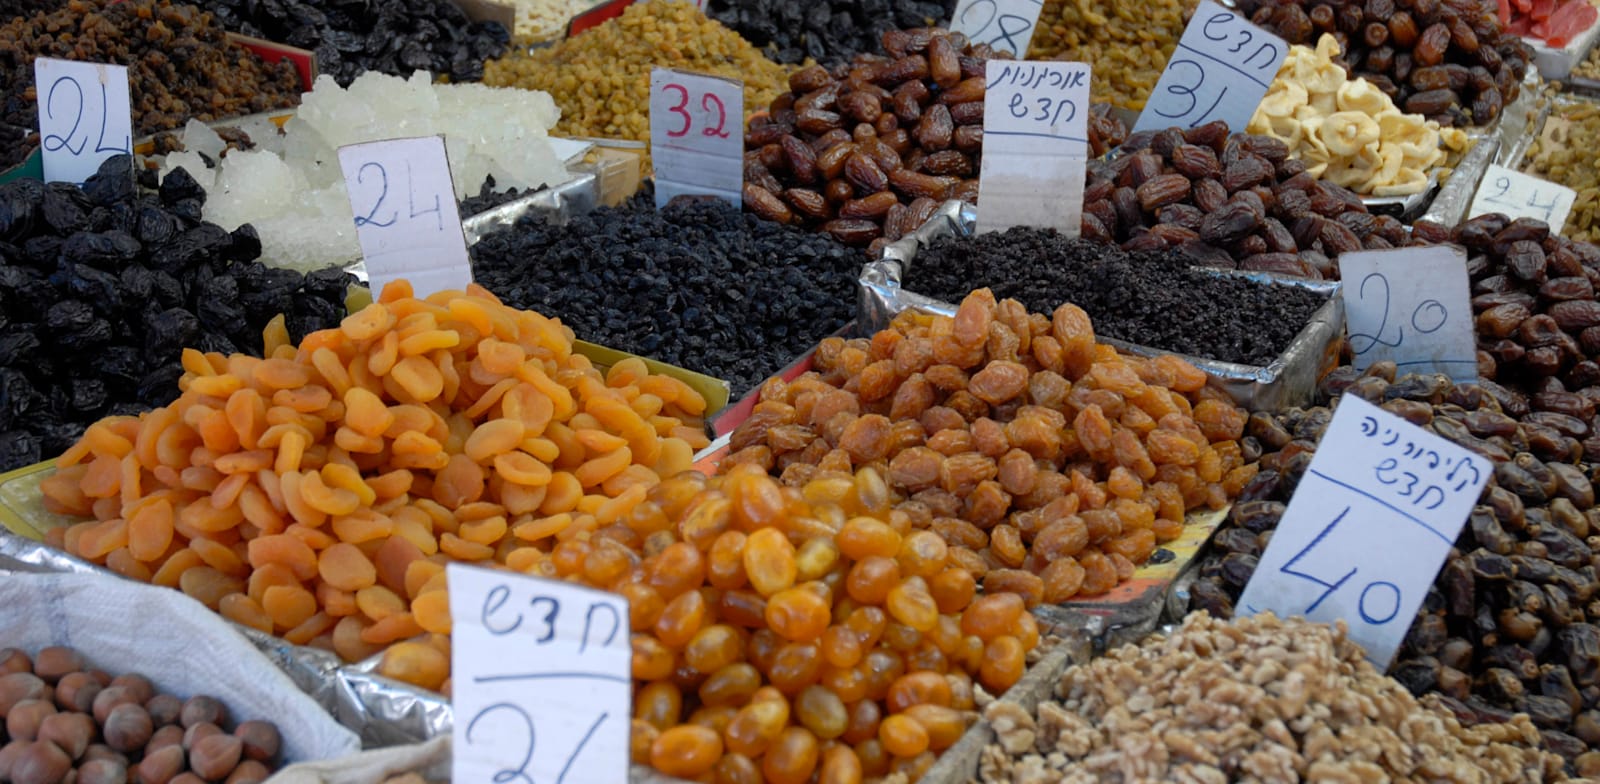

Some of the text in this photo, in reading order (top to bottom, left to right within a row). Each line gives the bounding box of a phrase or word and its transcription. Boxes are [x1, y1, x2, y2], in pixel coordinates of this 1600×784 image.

[1203, 12, 1277, 70] חדש
[986, 65, 1086, 90] אורגניות
[662, 83, 730, 139] 32
[1008, 92, 1076, 126] חדש
[354, 160, 443, 231] 24
[1484, 177, 1561, 221] 24
[1348, 272, 1448, 355] 20
[1374, 457, 1445, 510] חדש
[1280, 505, 1401, 625] 40
[481, 584, 621, 654] חדש
